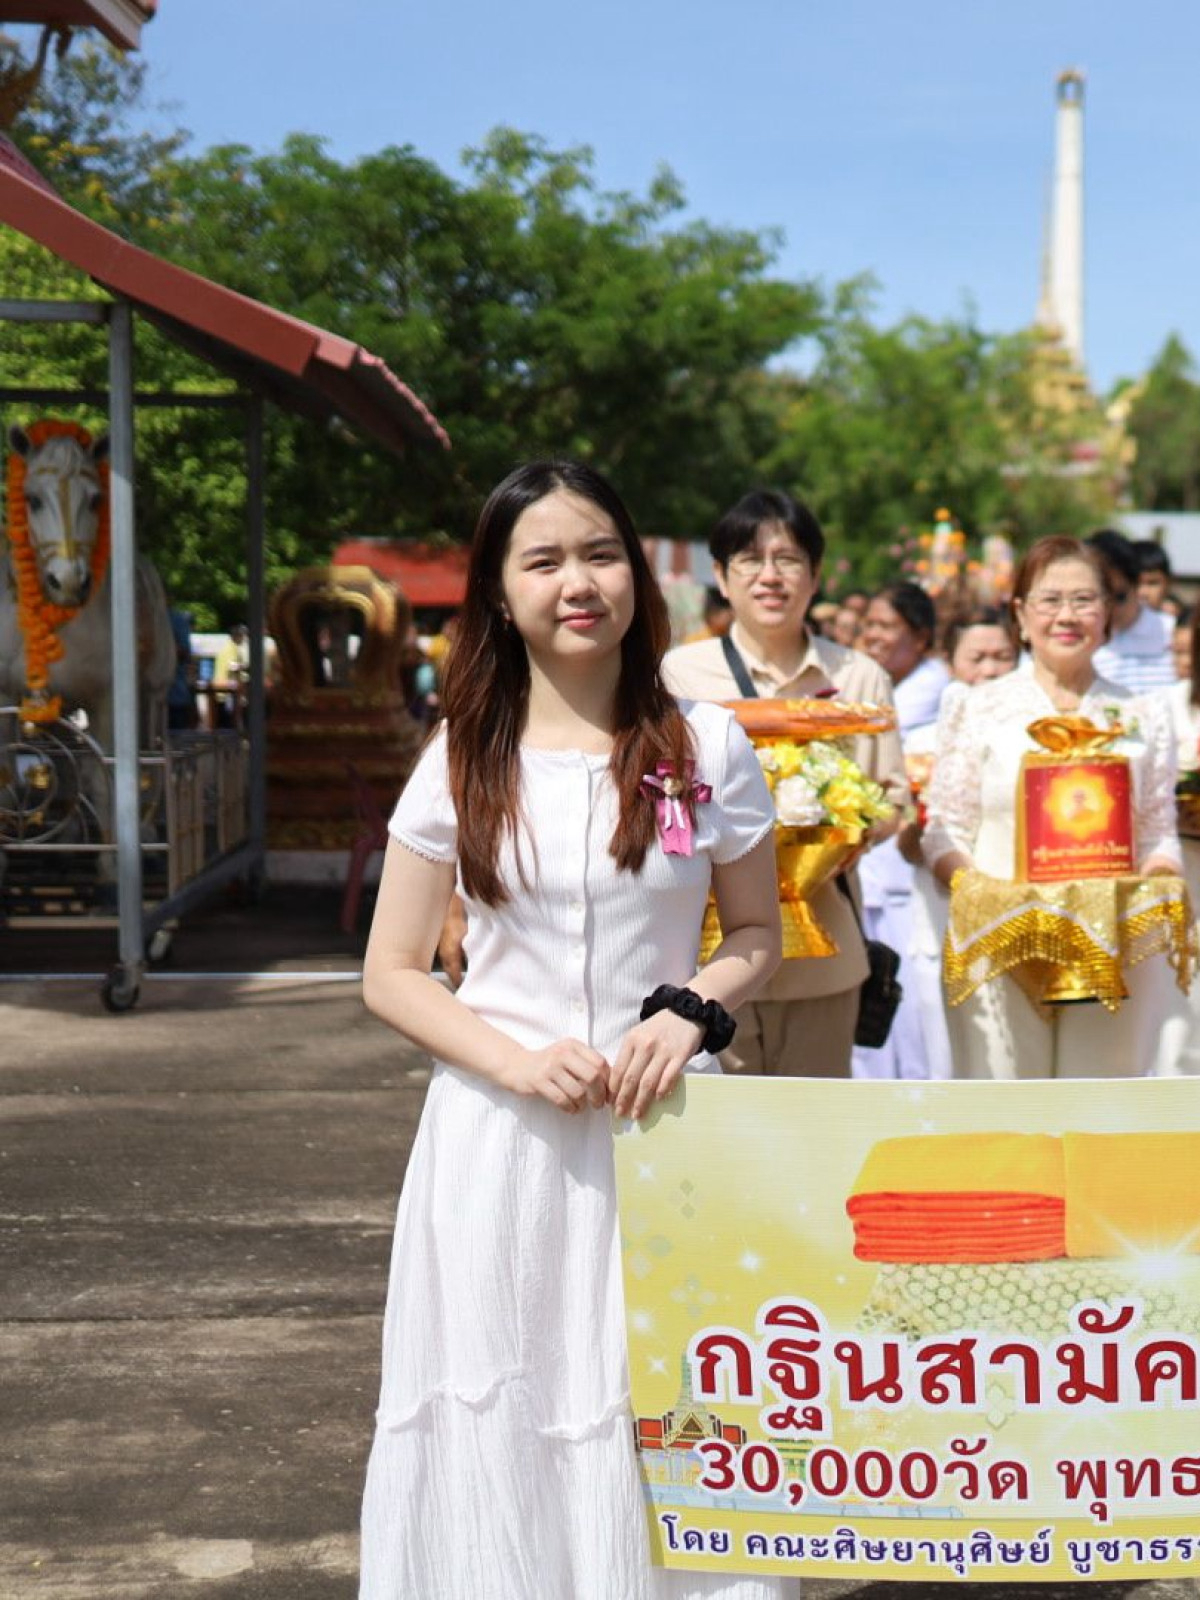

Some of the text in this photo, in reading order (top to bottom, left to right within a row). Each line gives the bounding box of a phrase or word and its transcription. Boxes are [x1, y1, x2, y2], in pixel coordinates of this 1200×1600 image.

[699, 1437, 1029, 1505] 30,000วัด
[661, 1514, 730, 1553] โดย
[746, 1528, 1052, 1575] คณะศิษยานุศิษย์
